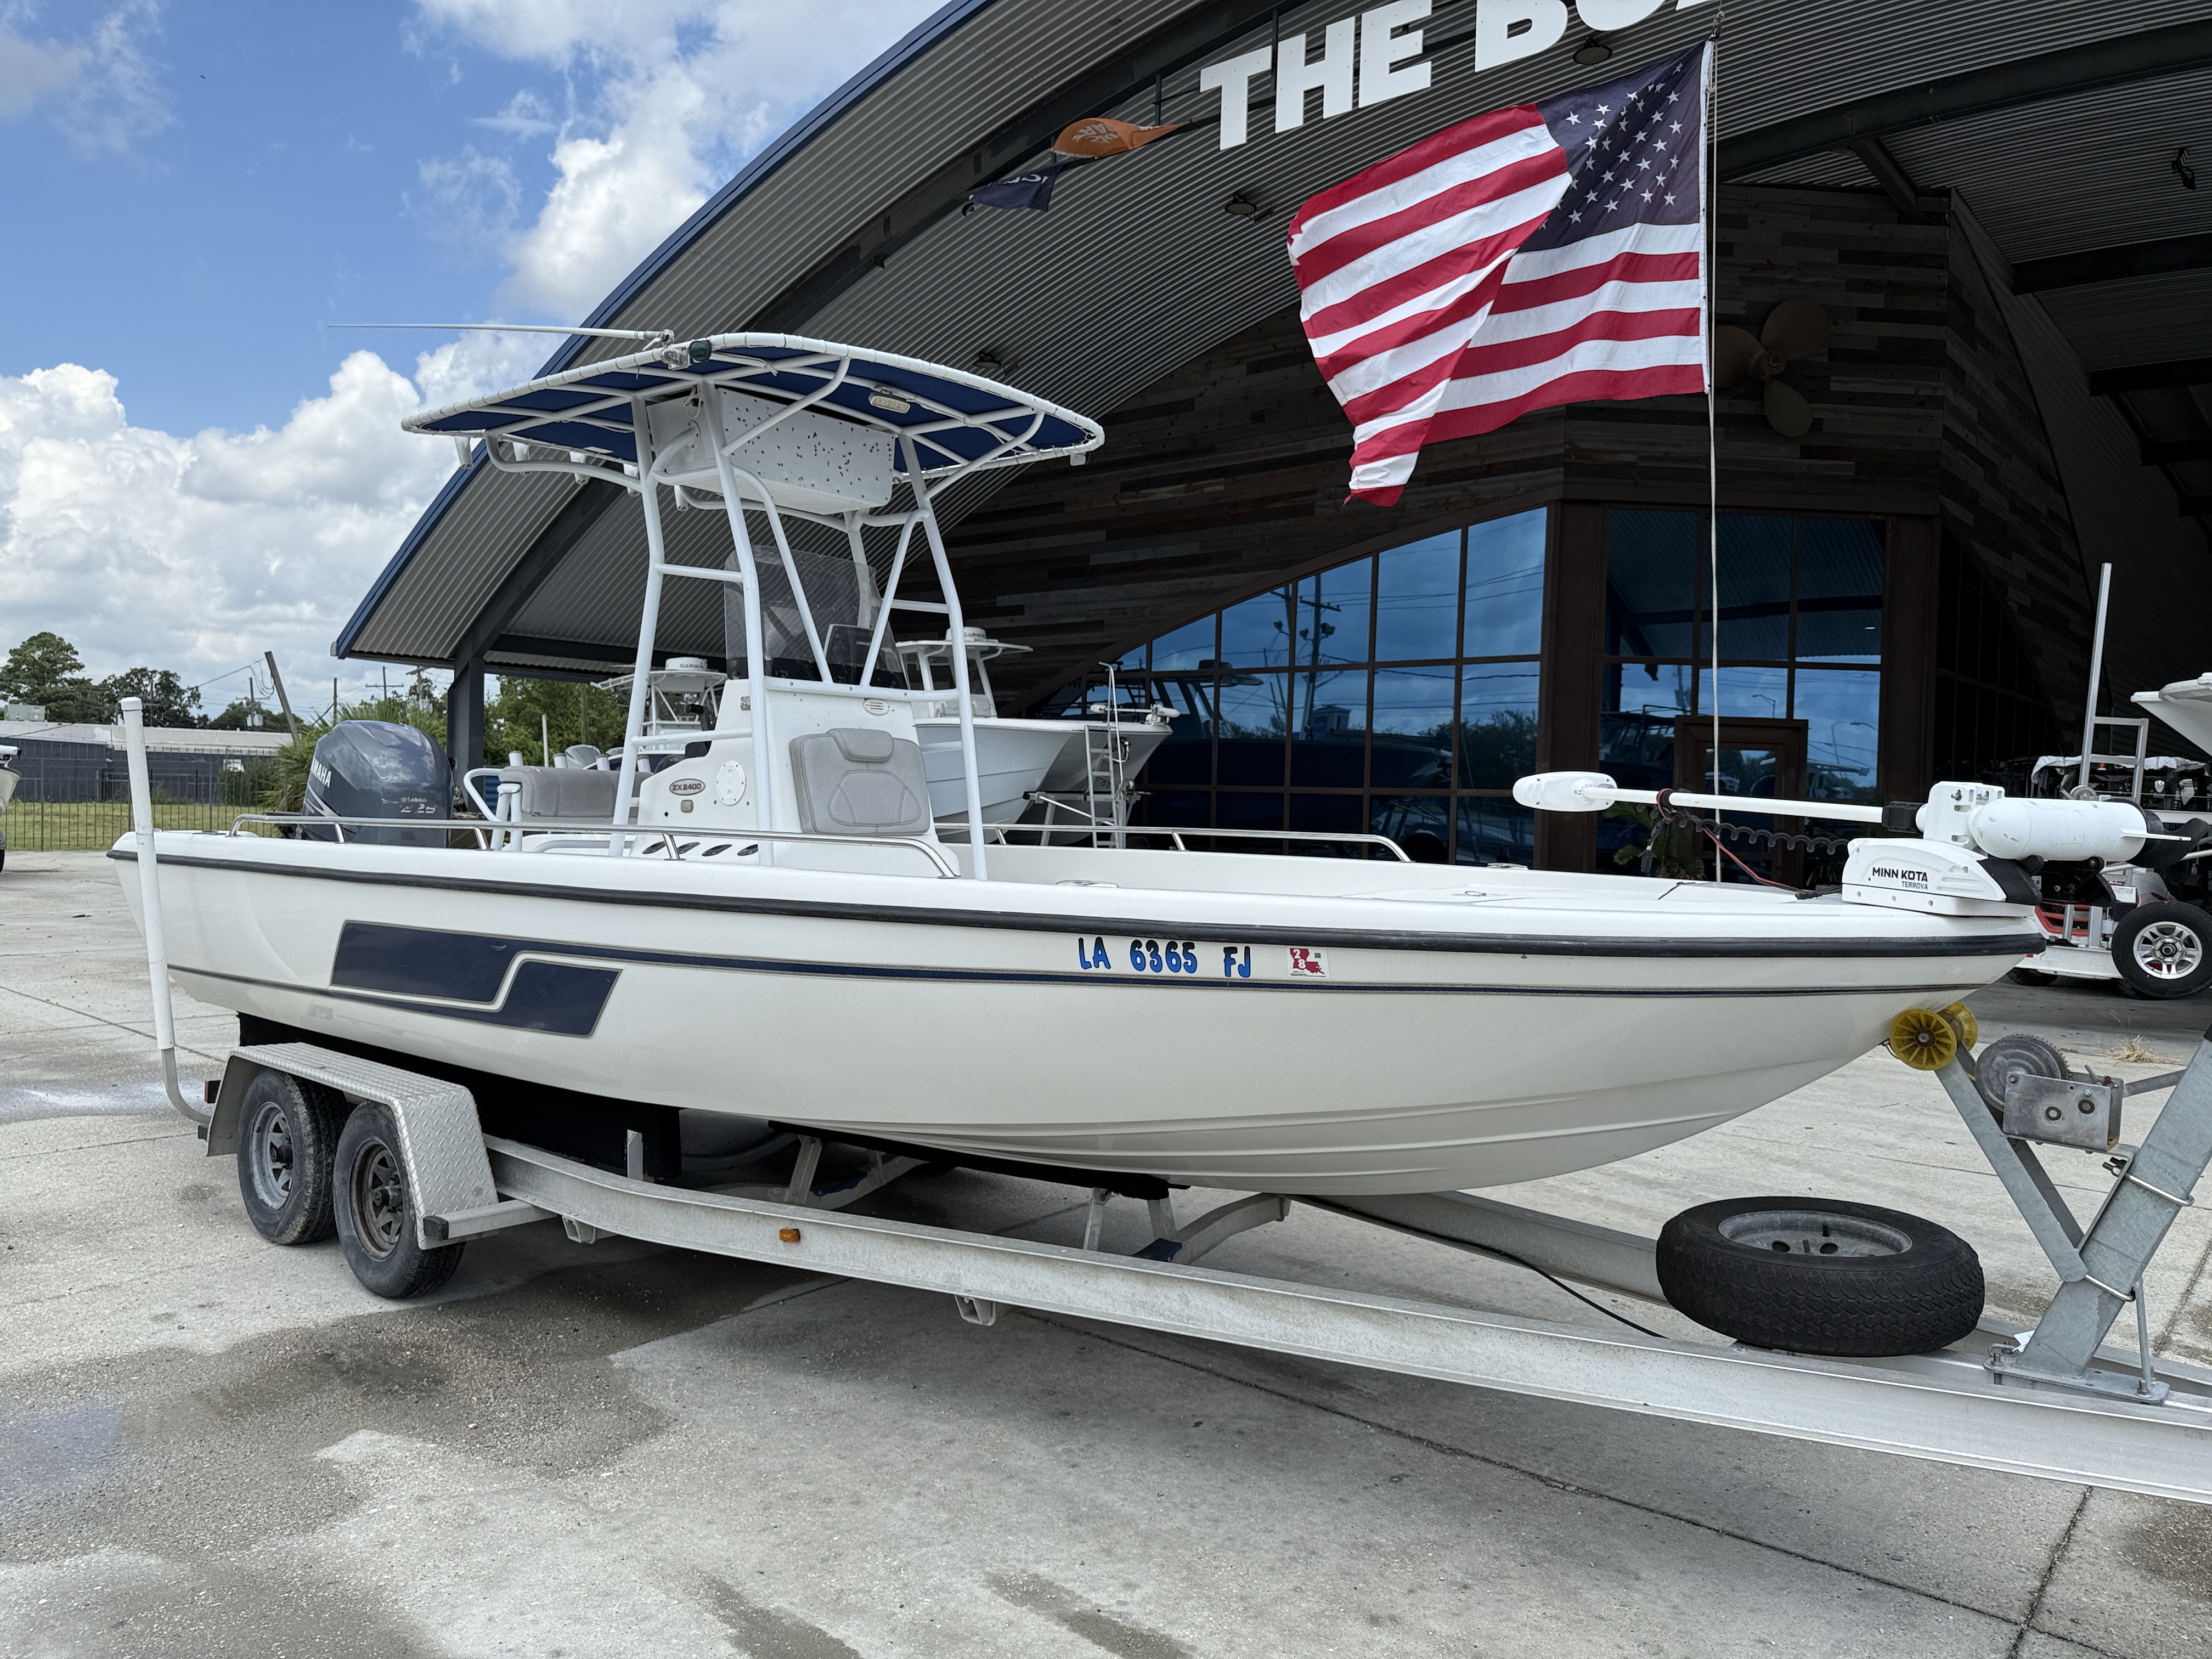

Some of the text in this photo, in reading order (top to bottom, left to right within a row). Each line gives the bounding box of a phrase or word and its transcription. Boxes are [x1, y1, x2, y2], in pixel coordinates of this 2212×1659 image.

[1200, 0, 1432, 150] THE
[1872, 866, 1928, 882] MINN KOTA
[1901, 881, 1929, 890] TERROVA
[1078, 936, 1251, 978] LA 6365 FJ
